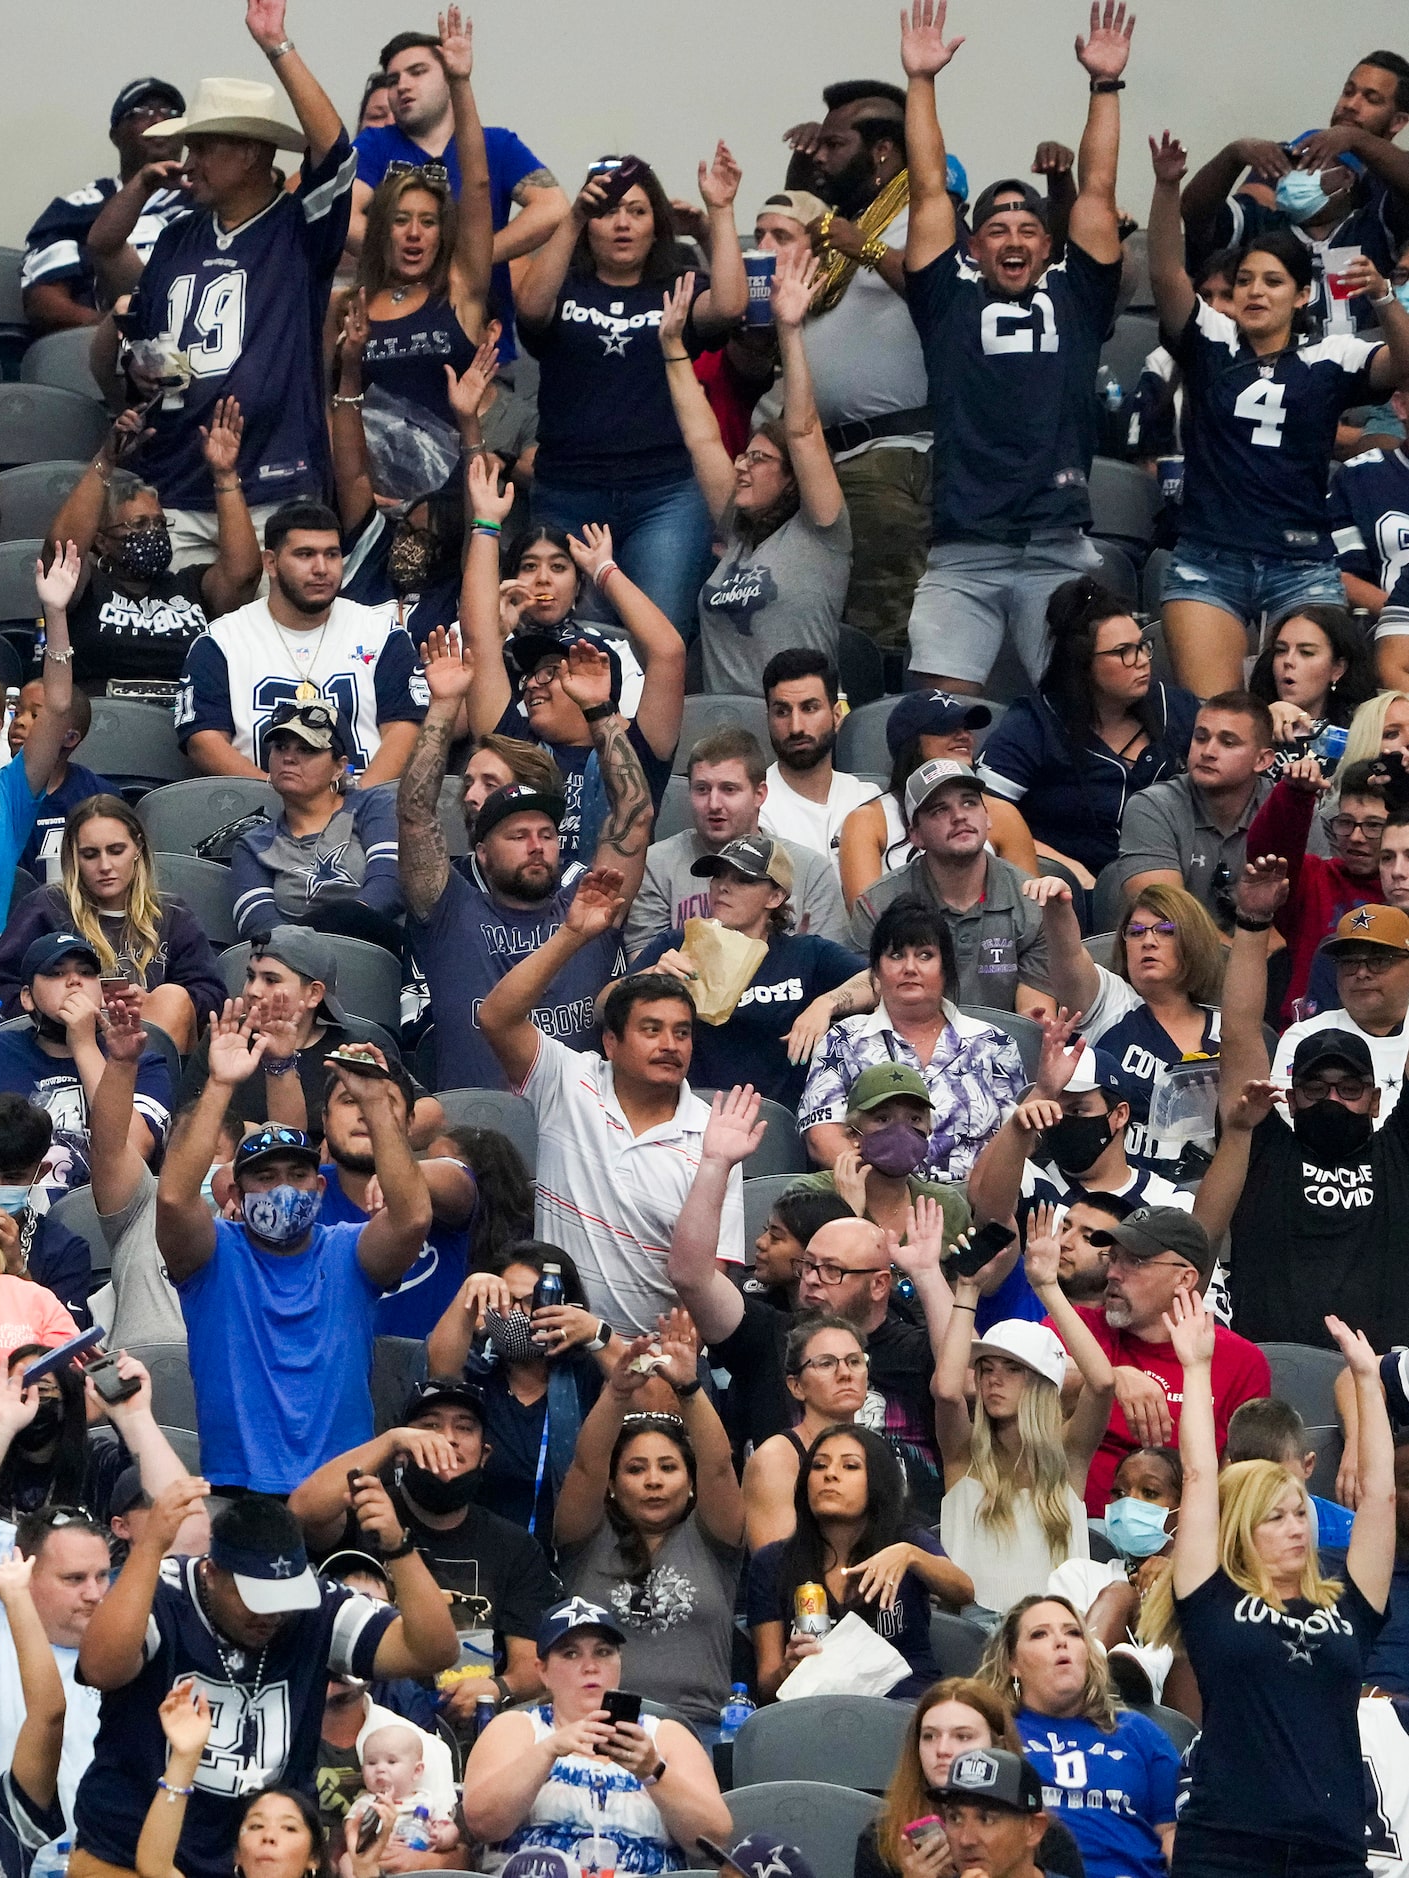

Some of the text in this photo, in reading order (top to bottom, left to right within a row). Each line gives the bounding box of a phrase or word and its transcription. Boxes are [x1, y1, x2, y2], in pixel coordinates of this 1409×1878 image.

[167, 269, 247, 380] 19
[1233, 377, 1287, 448] 4
[98, 601, 209, 635] COWBOYS
[252, 672, 370, 777] 21
[990, 948, 1004, 963] T
[1302, 1161, 1373, 1188] PINCHE
[1303, 1185, 1374, 1210] COVID
[166, 1671, 291, 1799] 21
[1053, 1750, 1089, 1790] D
